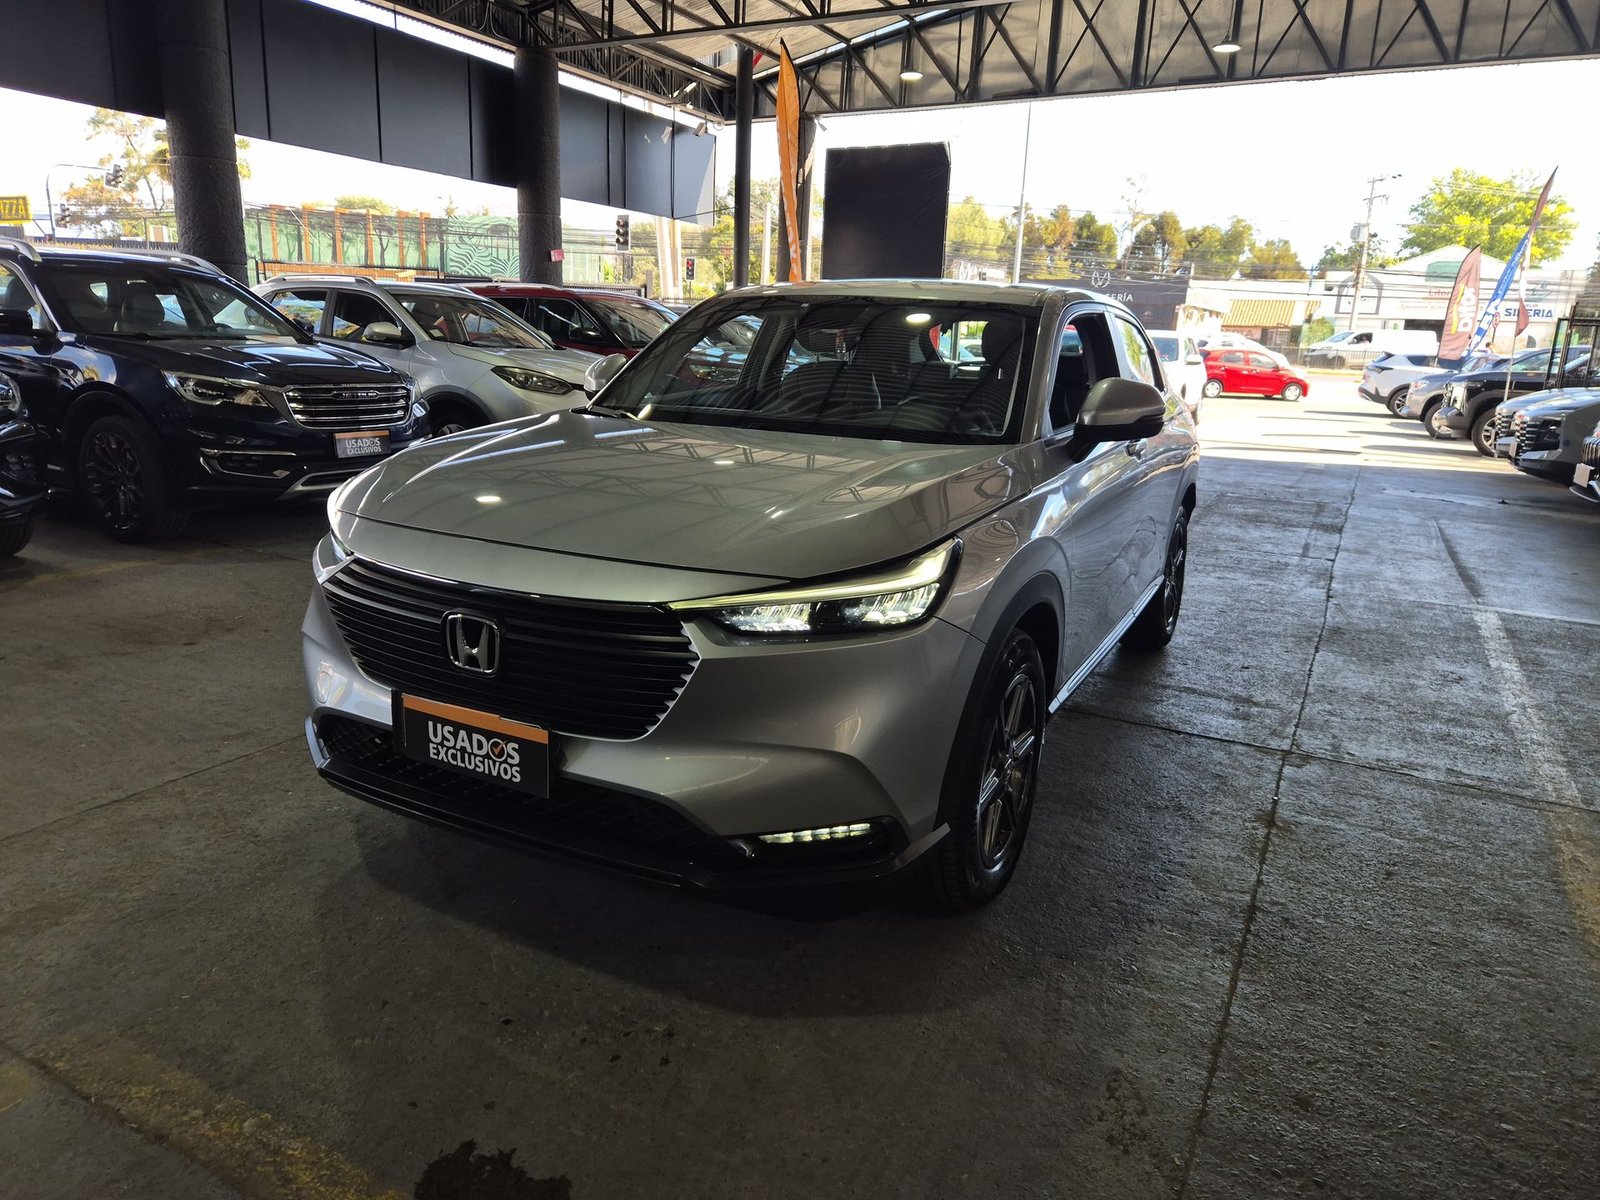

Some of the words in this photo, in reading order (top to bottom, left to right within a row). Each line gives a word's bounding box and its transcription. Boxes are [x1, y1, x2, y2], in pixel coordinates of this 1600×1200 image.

[1504, 308, 1553, 318] SIERIA
[345, 437, 381, 448] USADOS
[346, 445, 382, 455] EXCLUSIVOS
[428, 720, 520, 765] USADOS
[429, 742, 521, 783] EXCLUSIVOS
